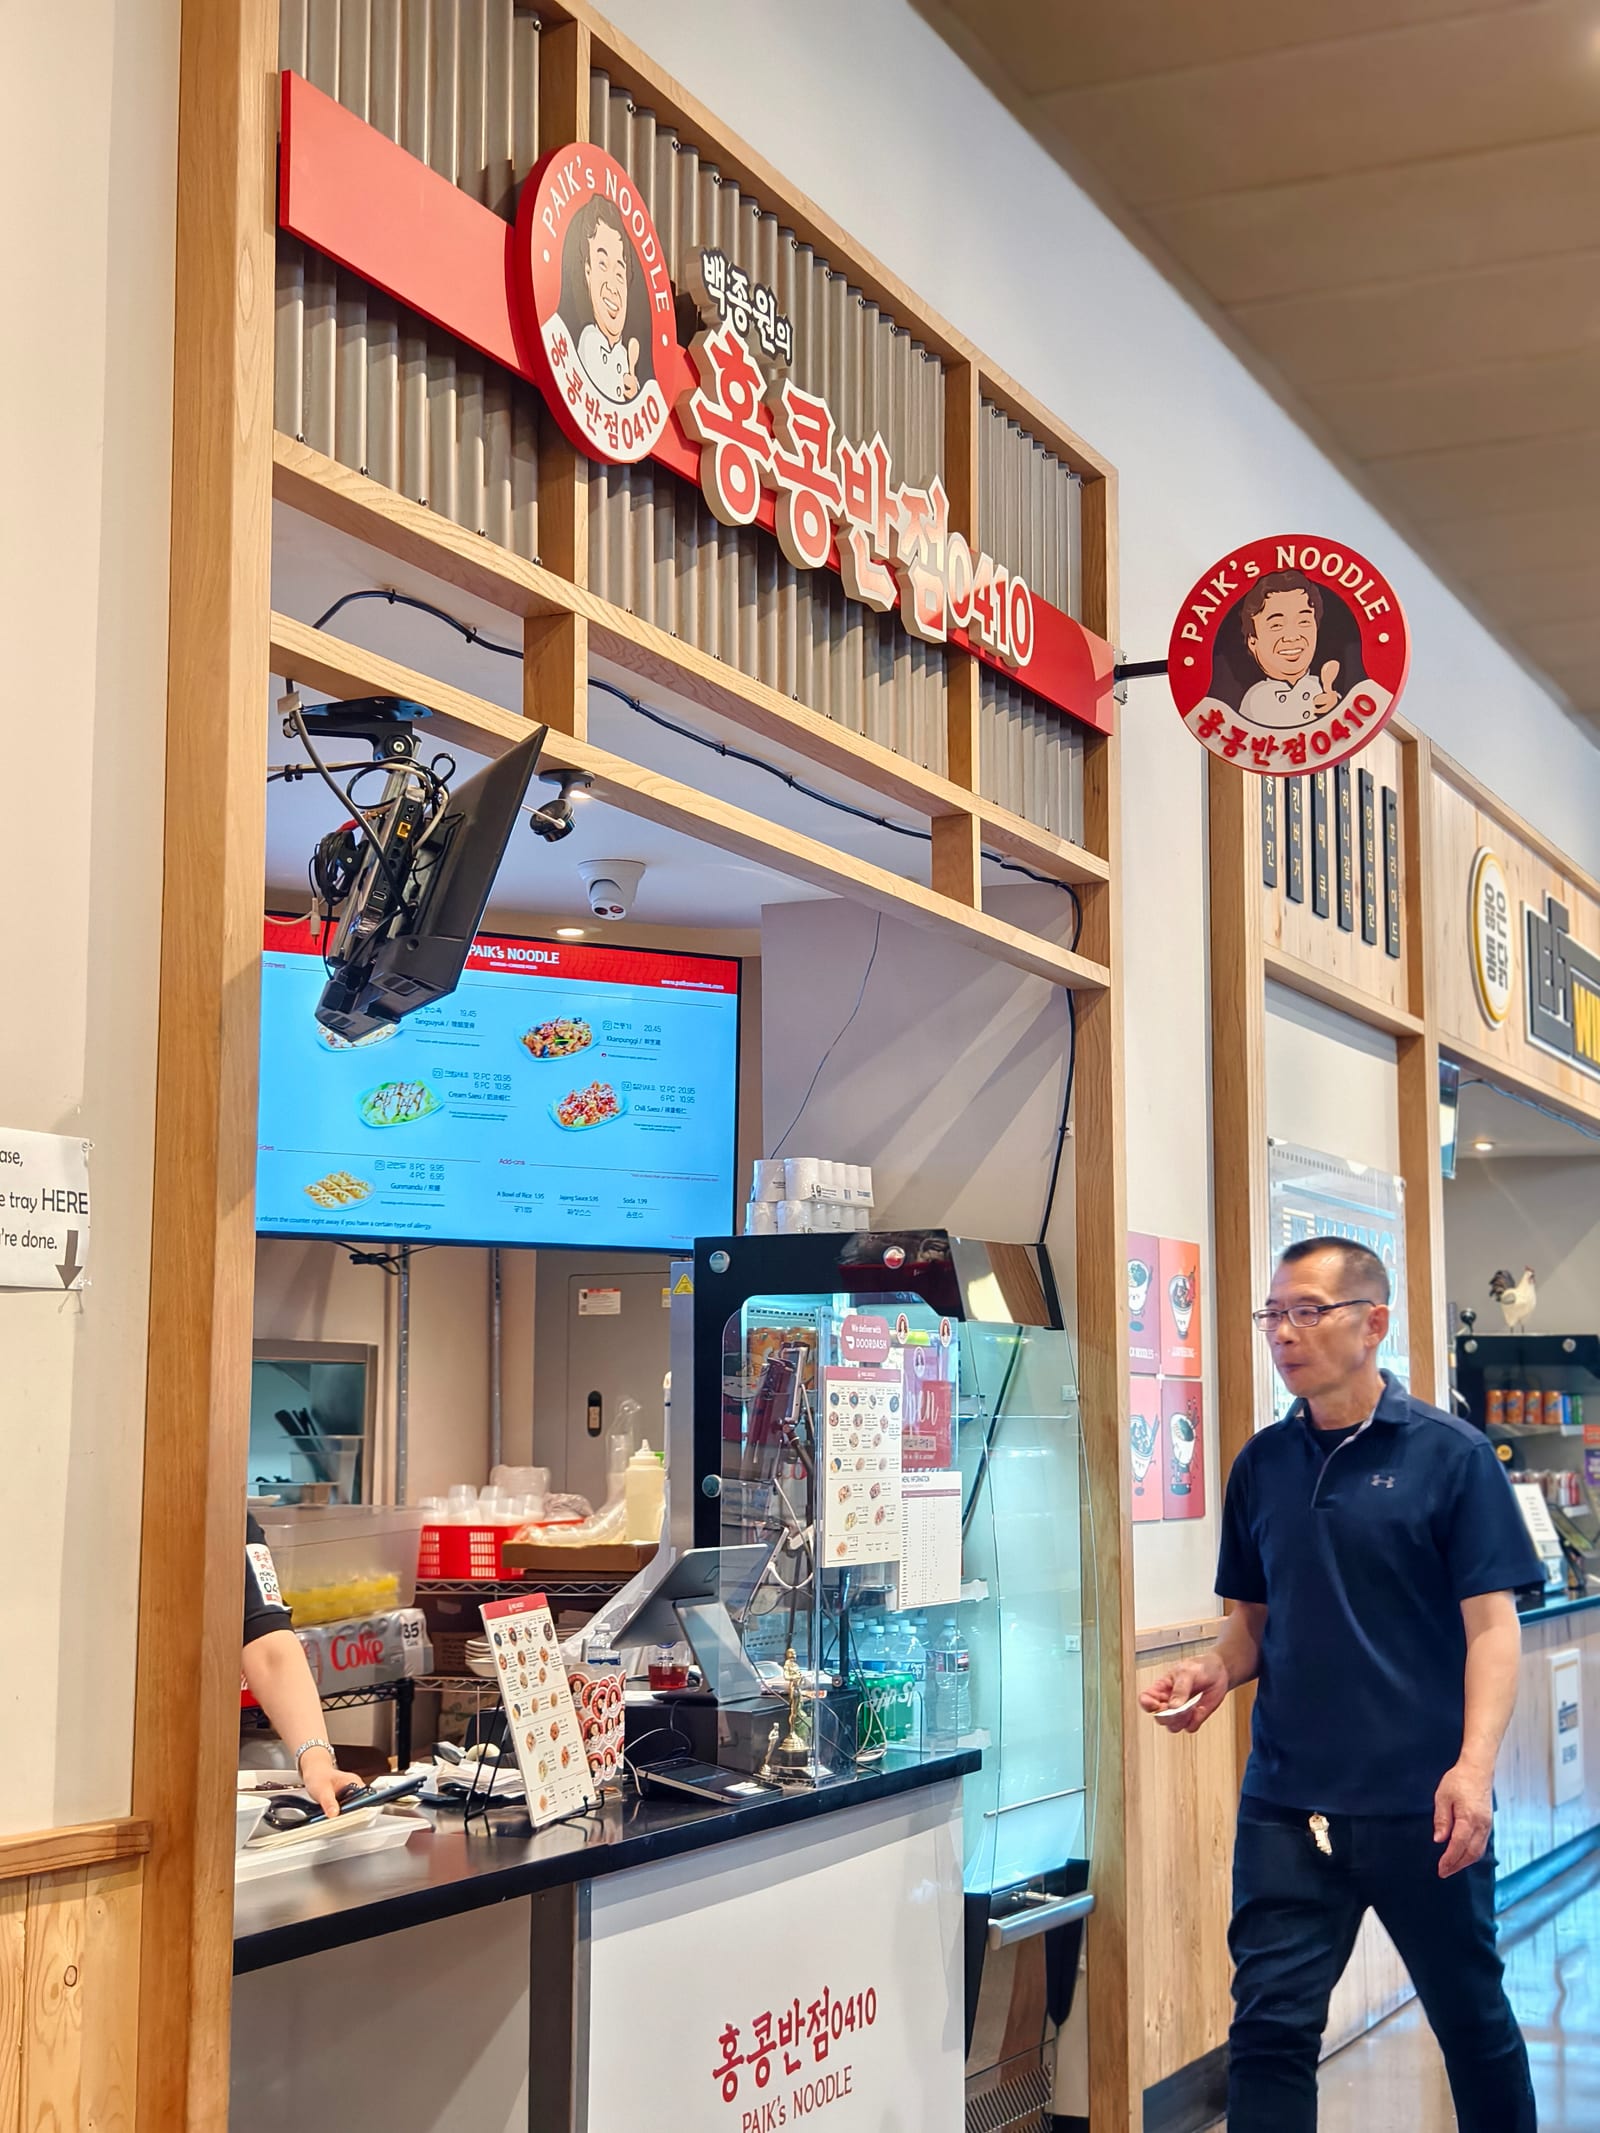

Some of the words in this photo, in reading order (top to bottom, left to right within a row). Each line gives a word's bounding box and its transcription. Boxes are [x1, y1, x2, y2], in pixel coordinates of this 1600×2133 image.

[541, 157, 596, 238] PAIK's
[605, 168, 670, 314] NOODLE
[701, 250, 794, 361] 백종원의
[550, 330, 661, 452] 홍콩반점0410
[694, 329, 1034, 665] 홍콩반점0410
[1180, 557, 1261, 643] PAIK's
[1276, 545, 1391, 622] NOODLE
[1195, 692, 1378, 767] 홍콩반점0410
[468, 944, 505, 959] PAIK's
[507, 947, 560, 964] NOODLE
[643, 1024, 662, 1033] 20.45
[472, 1072, 480, 1080] 12
[481, 1072, 491, 1081] PC
[493, 1073, 512, 1082] 20.95
[480, 1081, 490, 1090] PC
[494, 1082, 512, 1091] 10.95
[448, 1091, 467, 1099] Cream
[666, 1085, 676, 1093] PC
[678, 1086, 696, 1095] 20.95
[666, 1094, 675, 1102] PC
[679, 1095, 695, 1104] 10.95
[416, 1163, 426, 1171] PC
[416, 1171, 426, 1179] PC
[429, 1172, 445, 1180] 6.95
[9, 1191, 38, 1214] tray
[42, 1188, 89, 1215] HERE
[311, 1218, 325, 1226] right
[325, 1219, 340, 1227] away
[21, 1230, 58, 1249] done.
[856, 1338, 887, 1349] DOORDASH
[403, 1622, 420, 1639] 35
[330, 1632, 384, 1672] Coke
[711, 1985, 877, 2103] 홍콩반점0410
[742, 2095, 786, 2133] PAIK's
[793, 2064, 852, 2119] NOODLE
